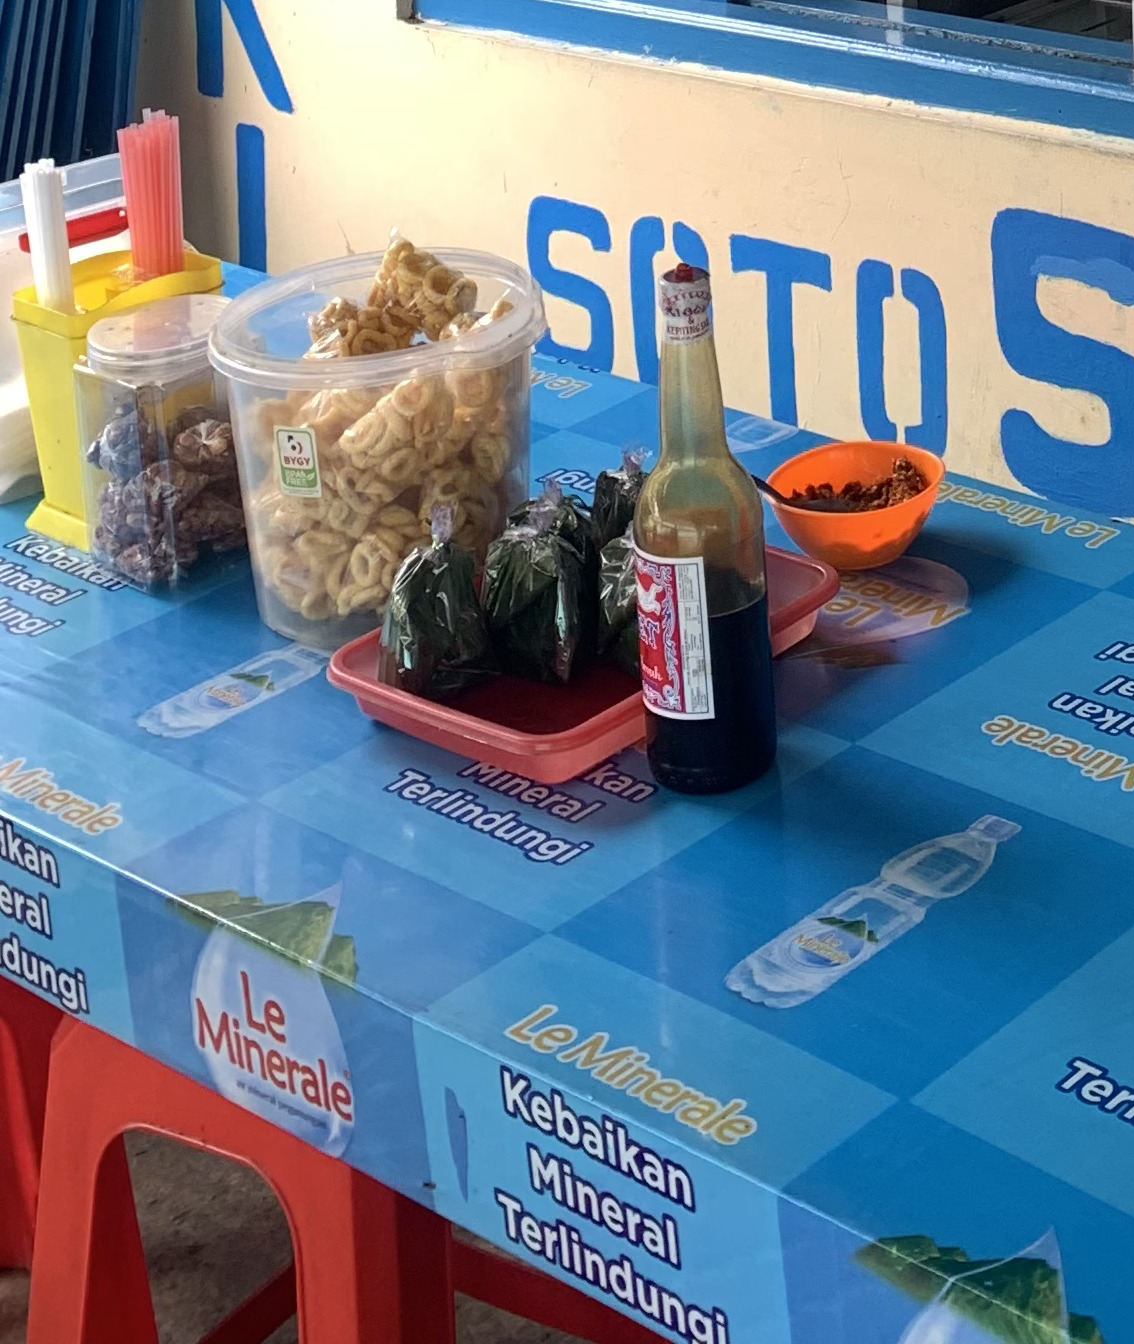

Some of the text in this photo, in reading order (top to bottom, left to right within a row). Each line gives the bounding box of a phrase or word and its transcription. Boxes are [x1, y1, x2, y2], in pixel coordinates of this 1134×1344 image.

[525, 195, 951, 462] SOTO
[283, 455, 311, 467] BYGY
[1067, 518, 1121, 549] Le
[822, 595, 882, 629] Le
[383, 768, 595, 866] Terlindungi
[195, 997, 353, 1122] Minerale
[239, 970, 287, 1044] Le
[505, 1004, 758, 1145] Le Minerale
[500, 1064, 697, 1213] Kebaikan
[493, 1186, 732, 1344] Terlindungi
[526, 1142, 682, 1270] Mineral
